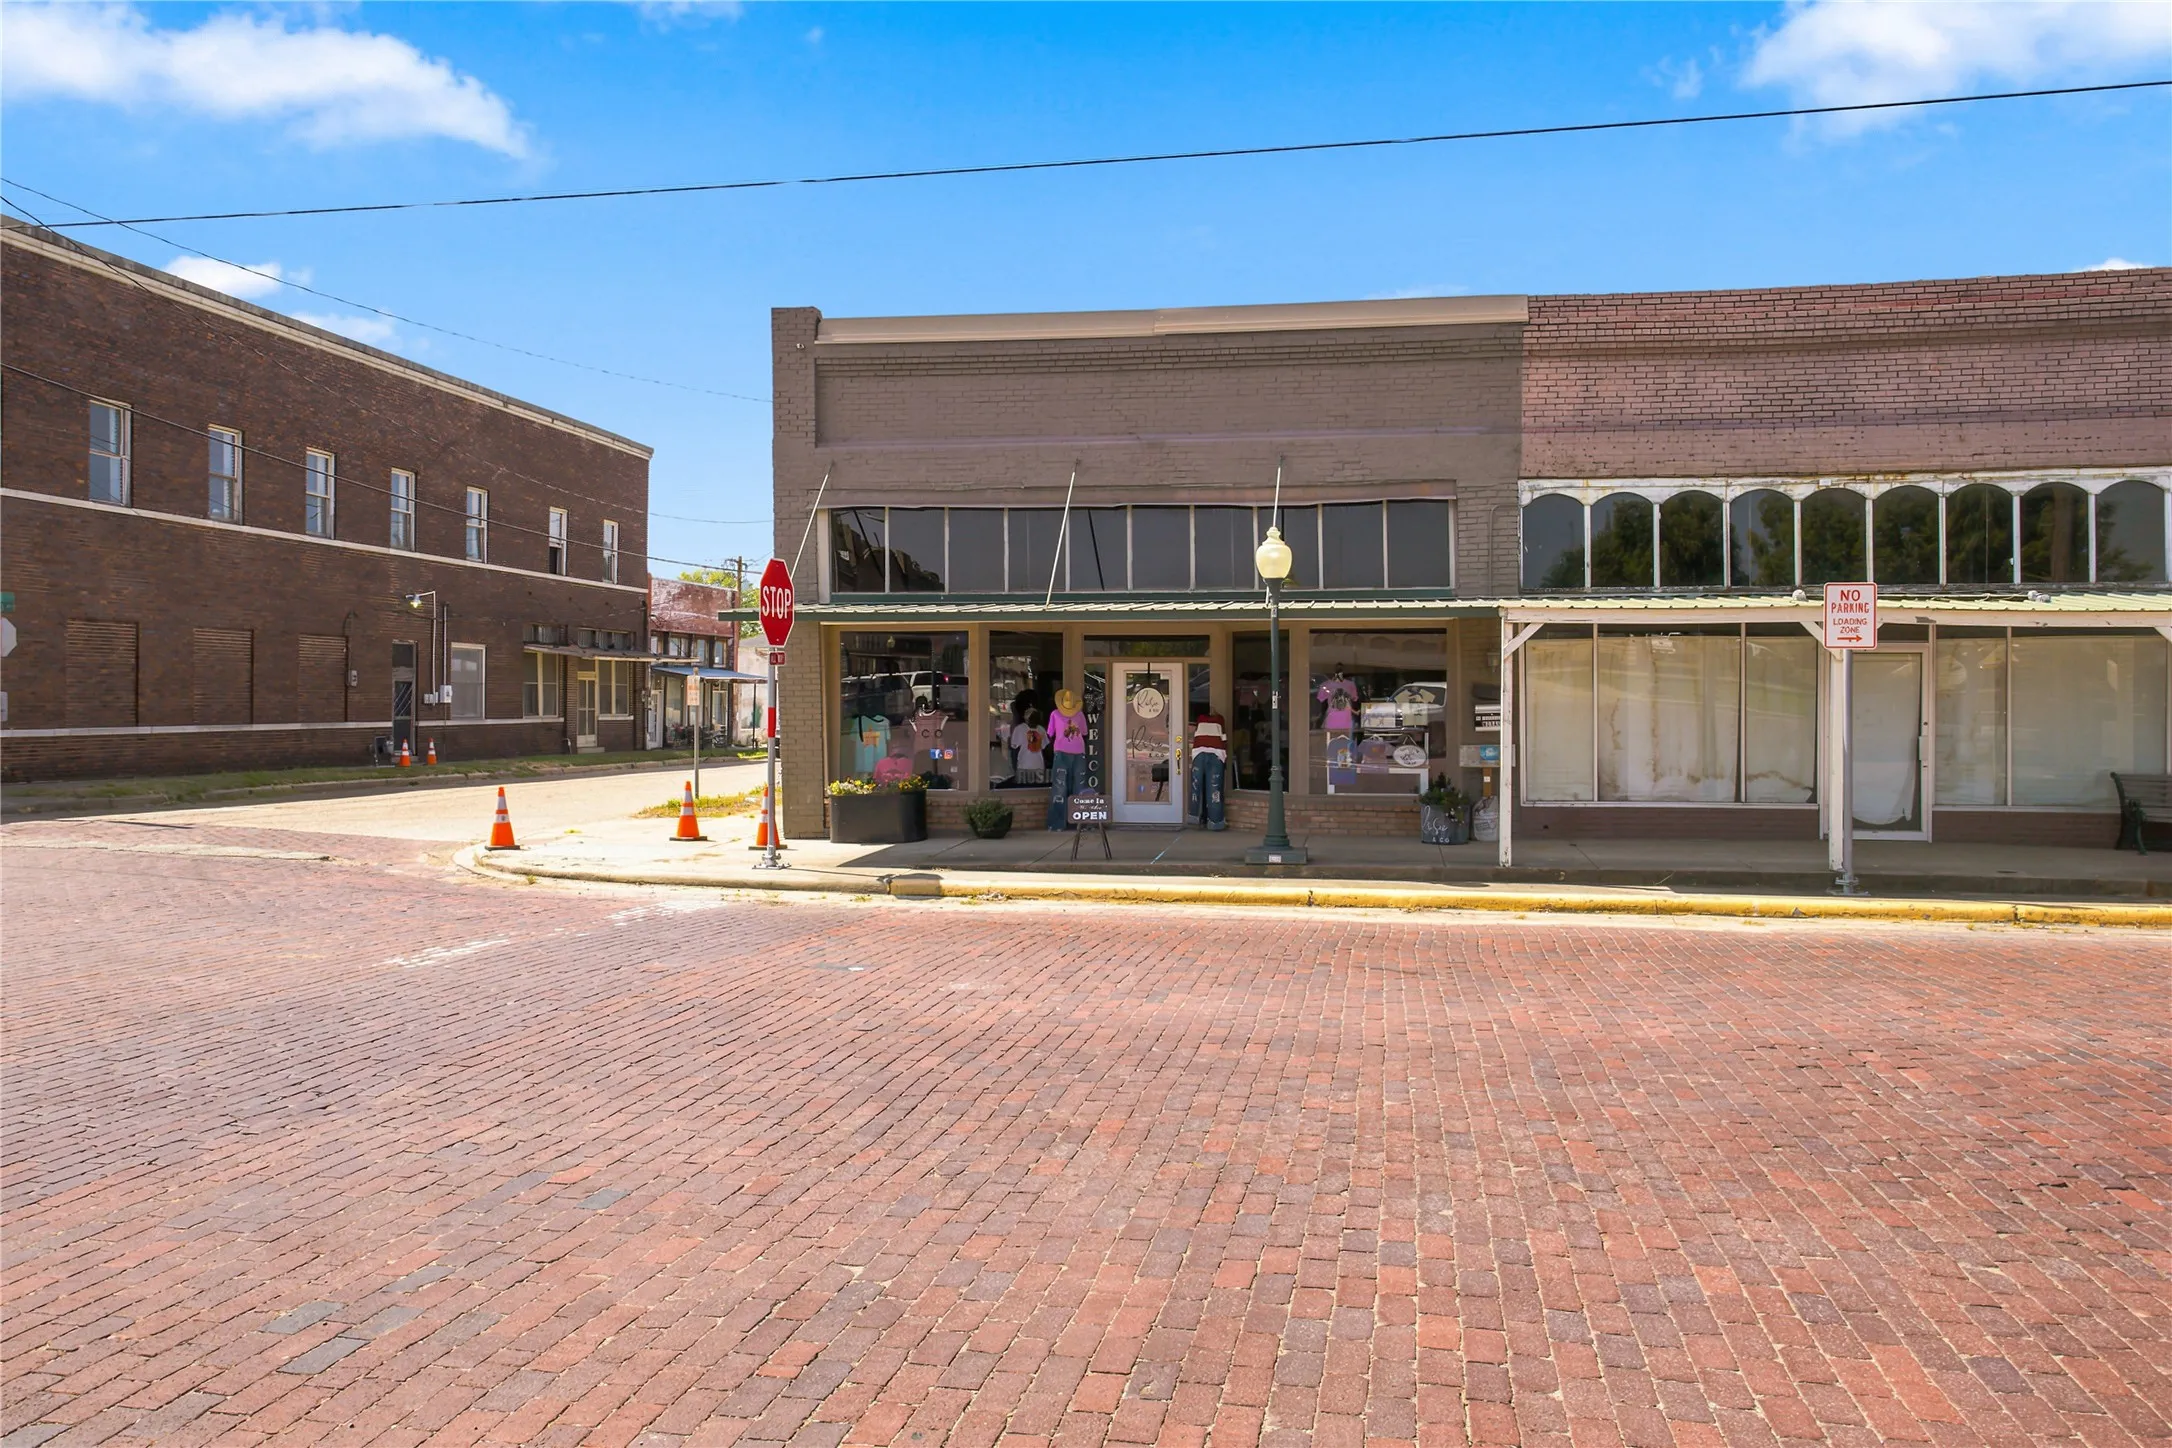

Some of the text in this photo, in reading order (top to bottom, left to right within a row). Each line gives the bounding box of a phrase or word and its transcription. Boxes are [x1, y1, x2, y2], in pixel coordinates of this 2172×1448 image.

[1840, 590, 1861, 601] NO
[762, 585, 792, 619] STOP
[1831, 602, 1870, 613] PARKING
[1087, 713, 1100, 788] WELCO
[1072, 811, 1107, 820] OPEN
